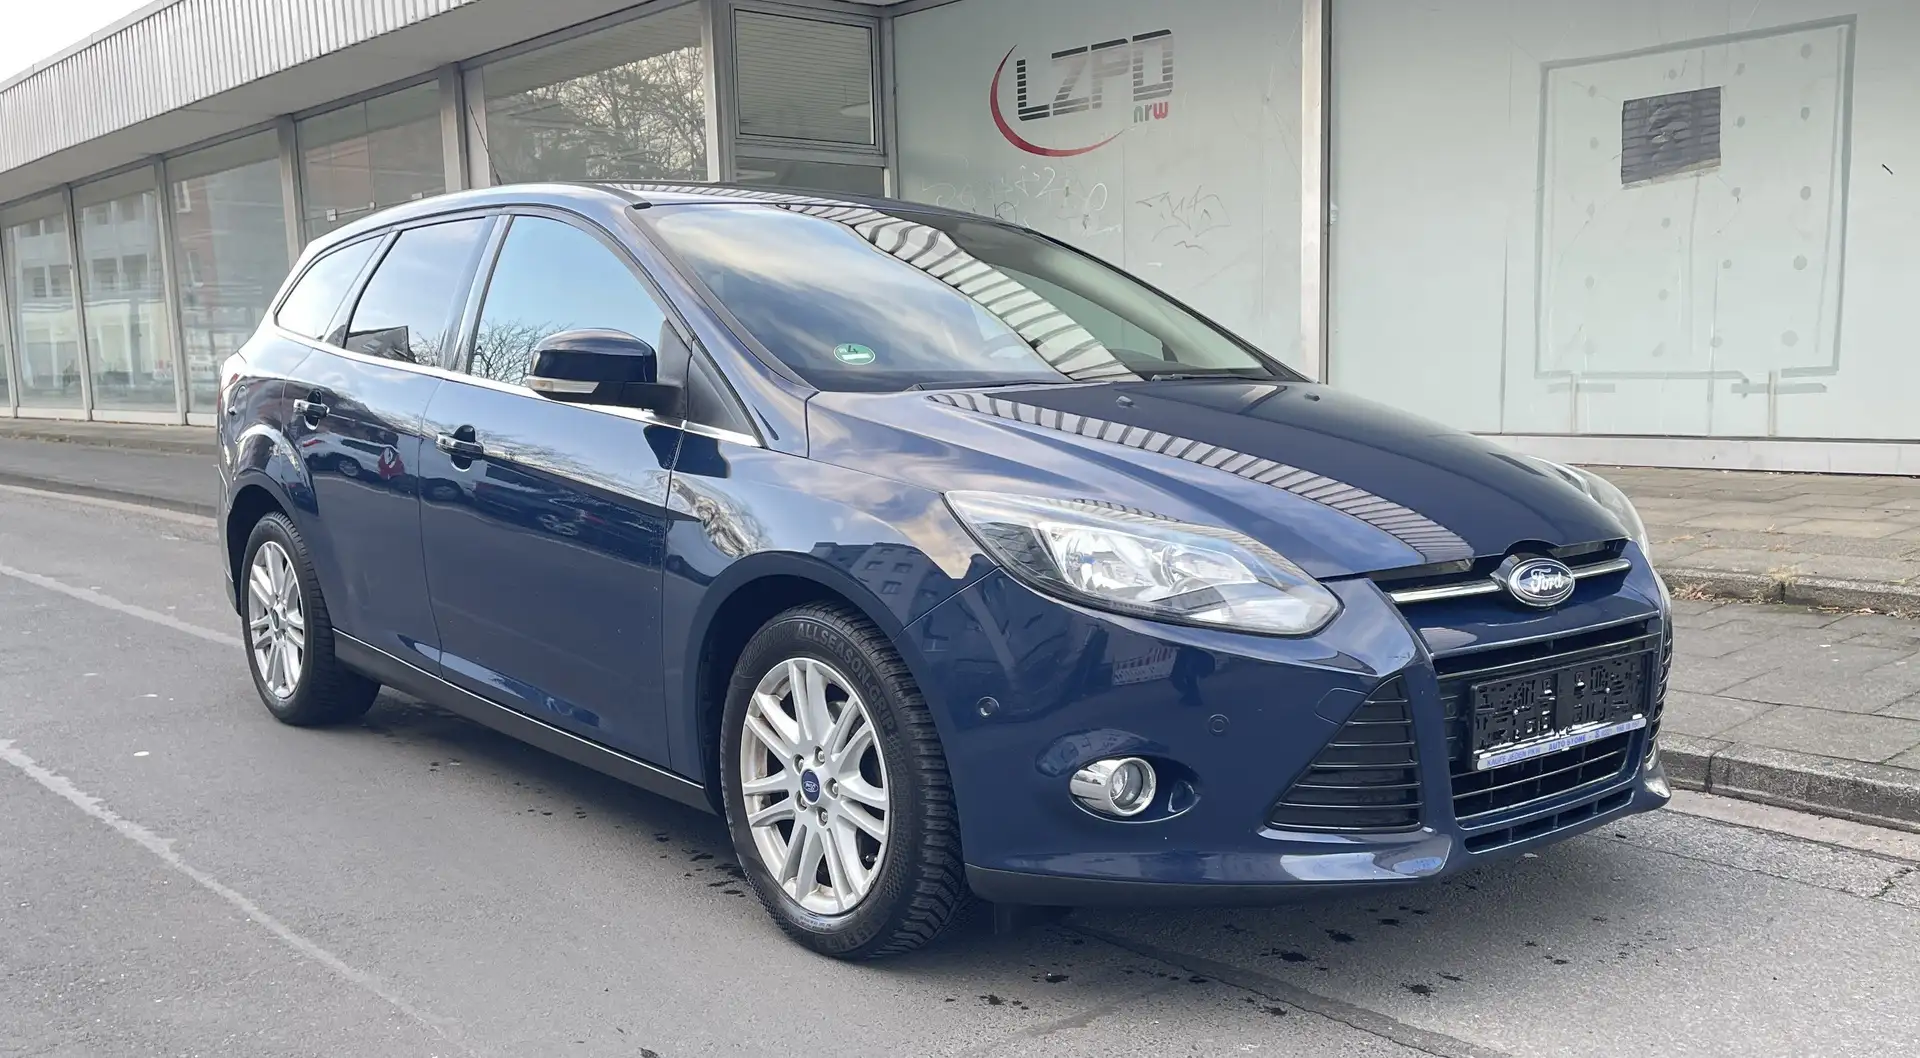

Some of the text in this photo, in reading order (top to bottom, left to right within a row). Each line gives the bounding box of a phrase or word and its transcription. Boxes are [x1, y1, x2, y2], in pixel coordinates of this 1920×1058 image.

[1133, 101, 1169, 123] nrw
[1531, 568, 1564, 593] Ford
[1548, 739, 1566, 751] AUTO
